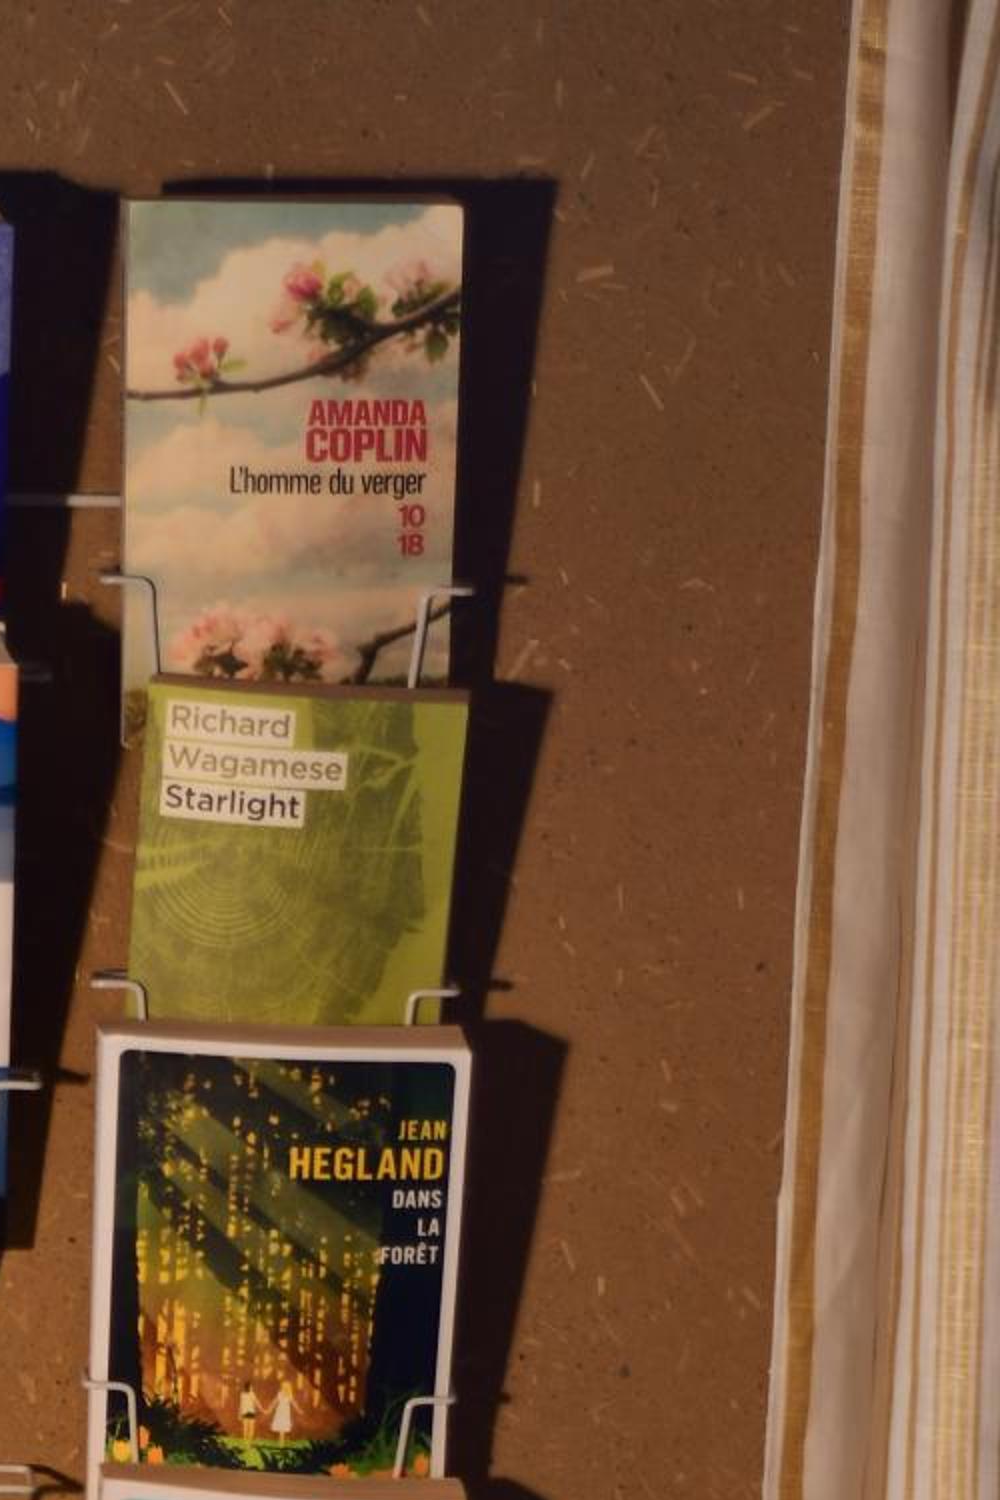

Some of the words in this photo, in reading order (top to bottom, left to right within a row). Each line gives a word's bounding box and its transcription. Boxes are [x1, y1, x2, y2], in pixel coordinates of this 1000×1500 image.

[308, 399, 426, 426] AMANDA
[306, 428, 427, 463] COPLIN
[230, 466, 321, 495] L'homme
[329, 467, 354, 495] du
[361, 473, 426, 500] verger
[398, 504, 425, 528] 10
[397, 533, 424, 556] 18
[171, 704, 291, 739] Richard
[168, 744, 343, 783] Wagamese
[165, 783, 300, 821] Starlight
[398, 1120, 447, 1140] JEAN
[289, 1146, 444, 1181] HEGLAND
[392, 1189, 442, 1209] DANS
[417, 1218, 440, 1237] LA
[380, 1241, 438, 1265] FORÊT
